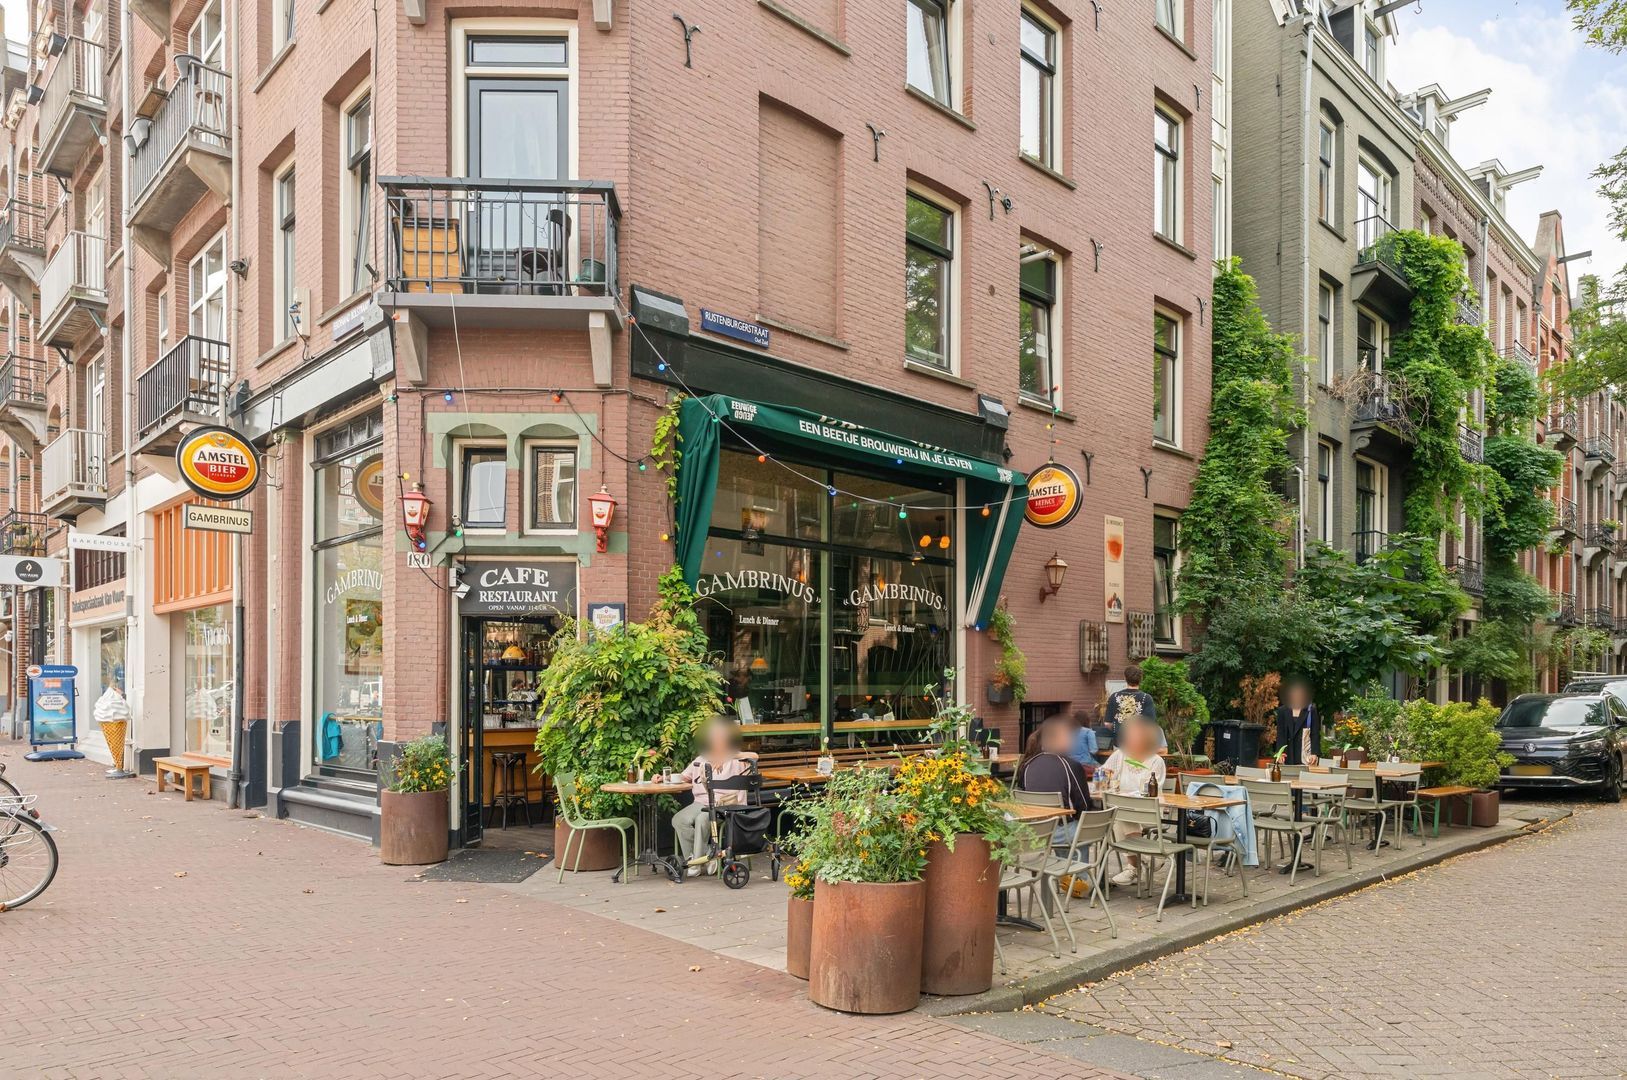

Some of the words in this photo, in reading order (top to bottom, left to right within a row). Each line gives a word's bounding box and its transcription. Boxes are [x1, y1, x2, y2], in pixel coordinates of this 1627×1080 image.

[799, 420, 821, 436] EEN
[822, 426, 860, 446] BEETJE
[860, 435, 919, 460] BROUWERIJ
[919, 451, 931, 462] IN
[931, 454, 944, 465] JE
[944, 456, 973, 471] LEVEN
[197, 450, 246, 465] AMSTEL
[209, 464, 237, 475] BIER
[1030, 485, 1063, 497] AMSTEL
[189, 511, 249, 527] GAMBRINUS
[72, 538, 131, 547] BAKEHOUSE
[407, 552, 431, 567] 180
[479, 567, 550, 588] CAFE
[326, 568, 383, 604] GAMBRINU
[479, 590, 559, 603] RESTAURANT
[739, 615, 755, 625] Lunch
[756, 616, 762, 625] &
[762, 616, 780, 626] Dinner
[884, 623, 897, 632] Lunch
[902, 624, 916, 633] Dinner
